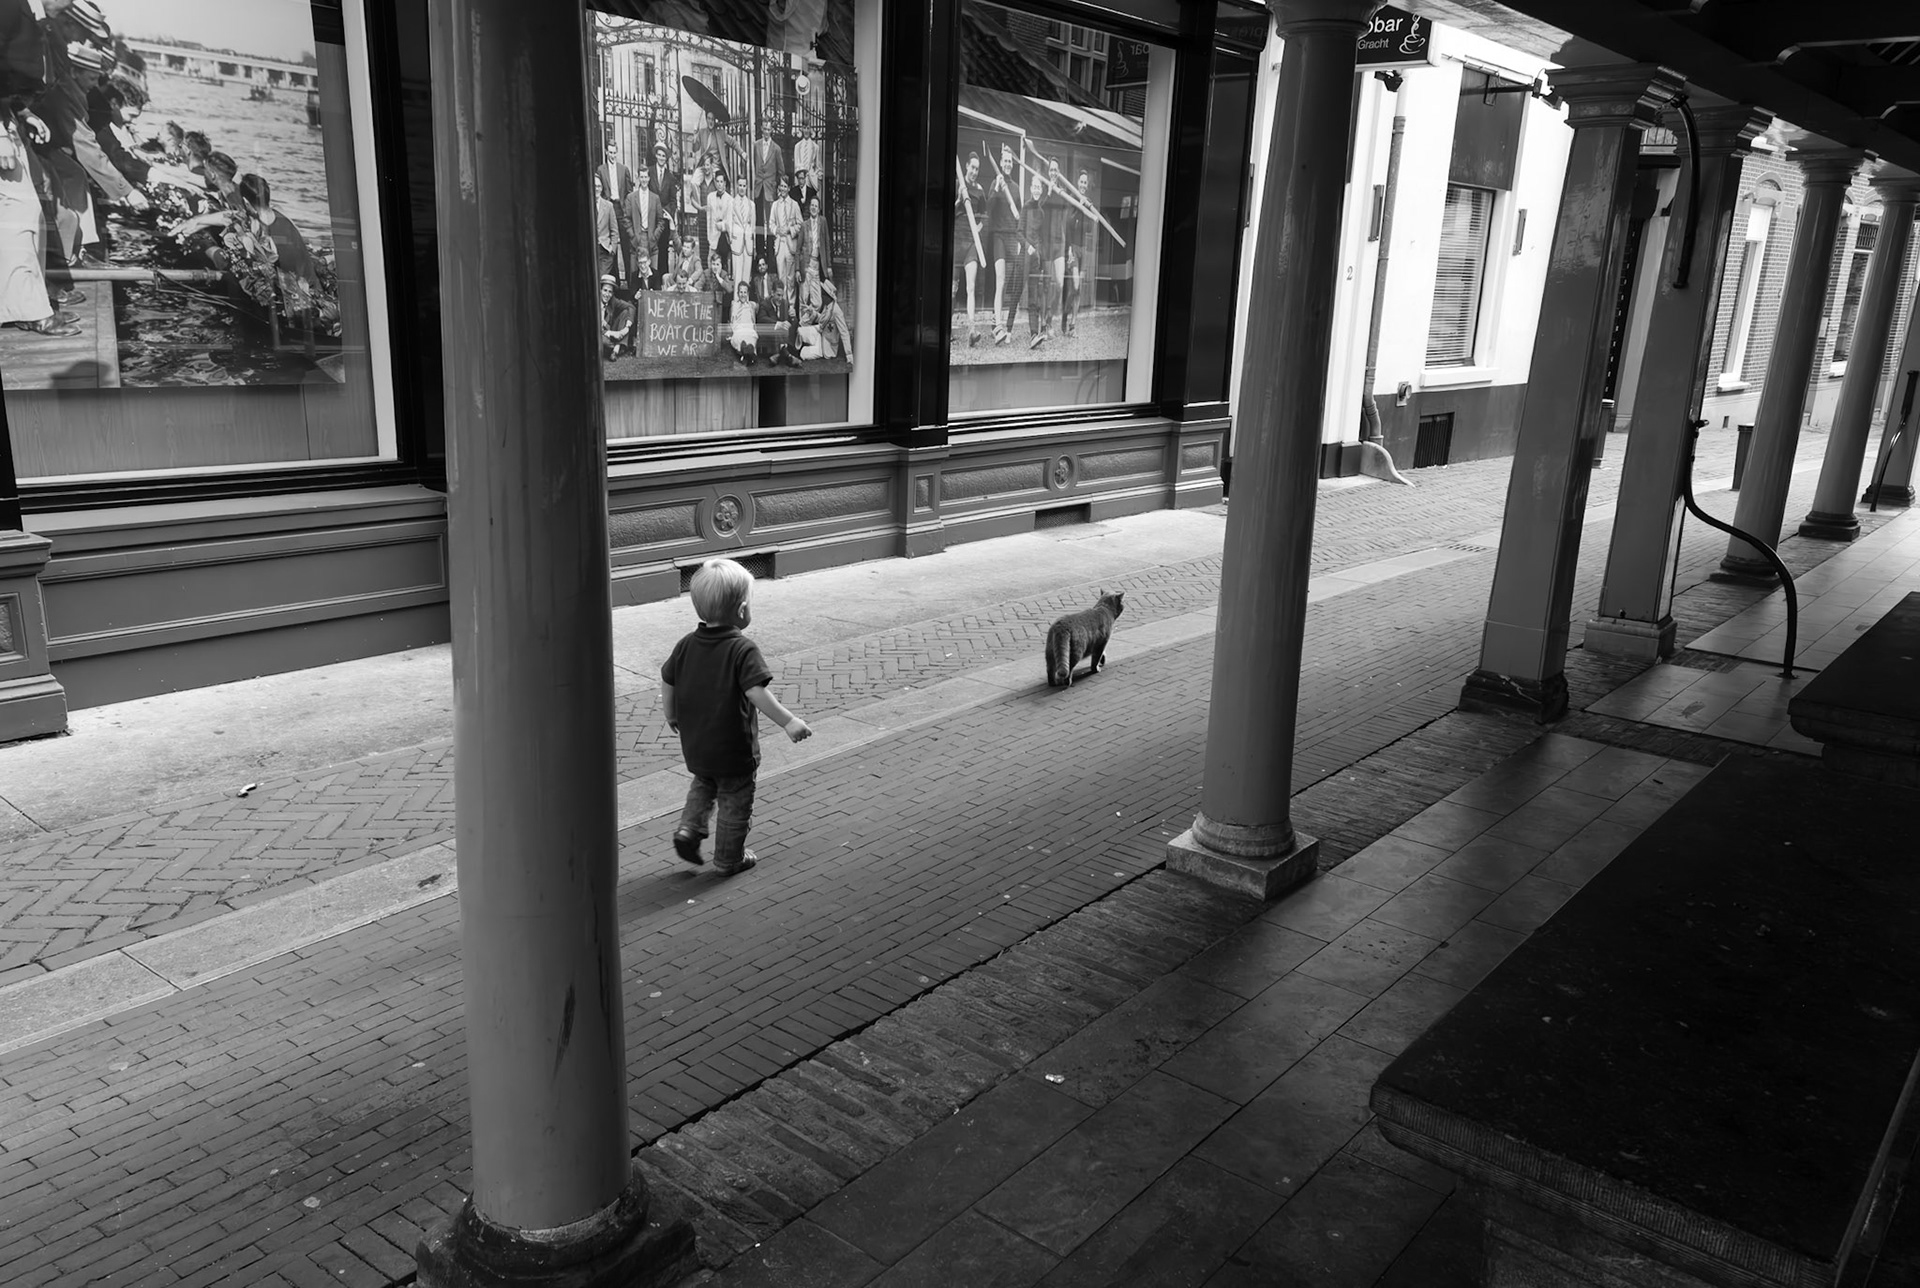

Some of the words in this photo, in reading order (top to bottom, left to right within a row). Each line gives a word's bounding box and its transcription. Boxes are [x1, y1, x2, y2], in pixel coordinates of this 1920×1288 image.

[1358, 38, 1389, 49] Gracht
[648, 297, 665, 318] WE
[667, 299, 690, 319] ARE
[692, 302, 713, 320] THE
[650, 322, 682, 342] BOAT
[683, 325, 714, 344] CLUB
[657, 345, 677, 357] WE
